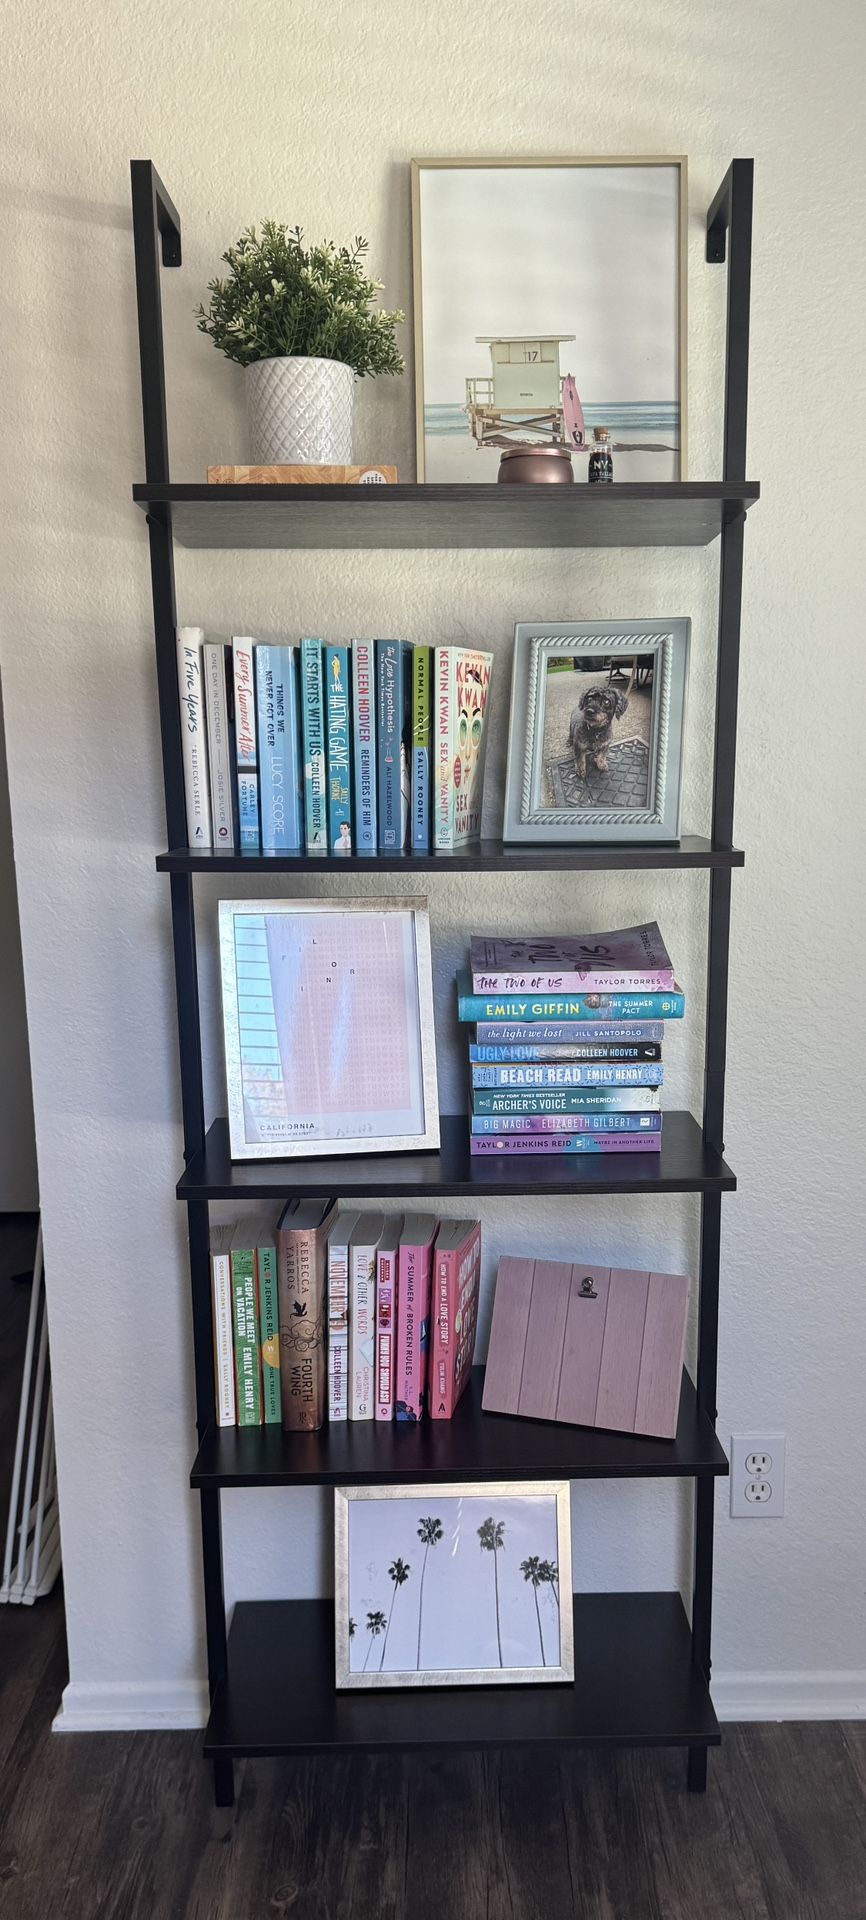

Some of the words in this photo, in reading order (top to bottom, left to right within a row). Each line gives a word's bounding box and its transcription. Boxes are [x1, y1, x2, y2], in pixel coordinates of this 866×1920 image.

[528, 351, 538, 361] 17
[594, 460, 608, 469] NV
[184, 647, 196, 657] In
[305, 647, 317, 659] IT
[387, 646, 395, 657] the
[186, 661, 199, 690] Five
[236, 650, 250, 682] Every
[356, 646, 369, 695] COLLEEN
[386, 658, 397, 678] Love
[440, 650, 449, 692] KEVIN
[213, 690, 219, 698] IN
[265, 670, 273, 700] NEVER
[306, 663, 319, 704] STARTS
[330, 682, 344, 693] THE
[238, 685, 252, 731] Summer
[276, 684, 284, 716] THINGS
[386, 680, 395, 733] Hypothesis
[182, 694, 199, 732] Years
[266, 702, 274, 721] GOT
[308, 708, 320, 737] WITH
[329, 695, 347, 733] HATING
[358, 698, 370, 742] HOOVER
[439, 696, 449, 735] KWAN
[267, 724, 275, 746] OVER
[277, 720, 285, 733] WE
[239, 733, 254, 761] After
[309, 741, 321, 756] US
[329, 737, 348, 773] GAME
[440, 742, 448, 763] SEX
[191, 749, 199, 787] REBECCA
[271, 757, 283, 789] LUCY
[311, 762, 320, 795] COLLEEN
[361, 750, 370, 795] REMINDERS
[340, 788, 349, 804] SALLY
[362, 798, 370, 808] OF
[440, 784, 448, 823] VANITY
[272, 795, 284, 834] SCORE
[313, 798, 321, 828] HOOVER
[362, 811, 371, 826] HIM
[504, 977, 525, 988] TWO
[531, 977, 544, 988] OF
[548, 978, 562, 987] US
[486, 1004, 527, 1016] EMILY
[532, 1003, 579, 1015] GIFFIN
[502, 1028, 526, 1040] light
[544, 1028, 562, 1037] lost
[477, 1047, 507, 1060] UGLY
[510, 1046, 541, 1060] LOVE
[576, 1049, 607, 1057] COLLEEN
[610, 1048, 638, 1056] HOOVER
[500, 1070, 542, 1083] BEACH
[548, 1068, 580, 1082] READ
[587, 1070, 613, 1079] EMILY
[616, 1070, 642, 1079] HENRY
[493, 1100, 537, 1110] ARCHER'S
[540, 1099, 566, 1109] VOICE
[484, 1120, 498, 1129] BIG
[502, 1120, 531, 1129] MAGIC
[542, 1118, 590, 1128] ELIZABETH
[593, 1118, 630, 1127] GILBERT
[286, 1247, 294, 1290] YARROS
[300, 1241, 309, 1294] REBECCA
[358, 1255, 367, 1272] LOVE
[236, 1287, 242, 1296] ON
[244, 1277, 253, 1306] PEOPLE
[331, 1260, 346, 1313] NOVEMBER
[358, 1282, 367, 1304] OTHER
[246, 1308, 254, 1321] WE
[264, 1287, 273, 1320] JENKINS
[407, 1304, 414, 1312] of
[440, 1303, 448, 1320] LOVE
[236, 1297, 246, 1337] VACATION
[358, 1309, 367, 1335] WORDS
[247, 1322, 255, 1344] MEET
[440, 1322, 448, 1344] STORY
[380, 1335, 390, 1354] FUNNY
[243, 1347, 252, 1375] EMILY
[334, 1346, 342, 1373] COLLEEN
[380, 1355, 390, 1367] YOU
[405, 1350, 413, 1376] RULES
[291, 1365, 300, 1396] WING
[302, 1359, 313, 1402] FOURTH
[362, 1366, 370, 1401] CHRISTINA
[380, 1368, 390, 1390] SHOULD
[245, 1379, 254, 1409] HENRY
[380, 1391, 390, 1403] ASK
